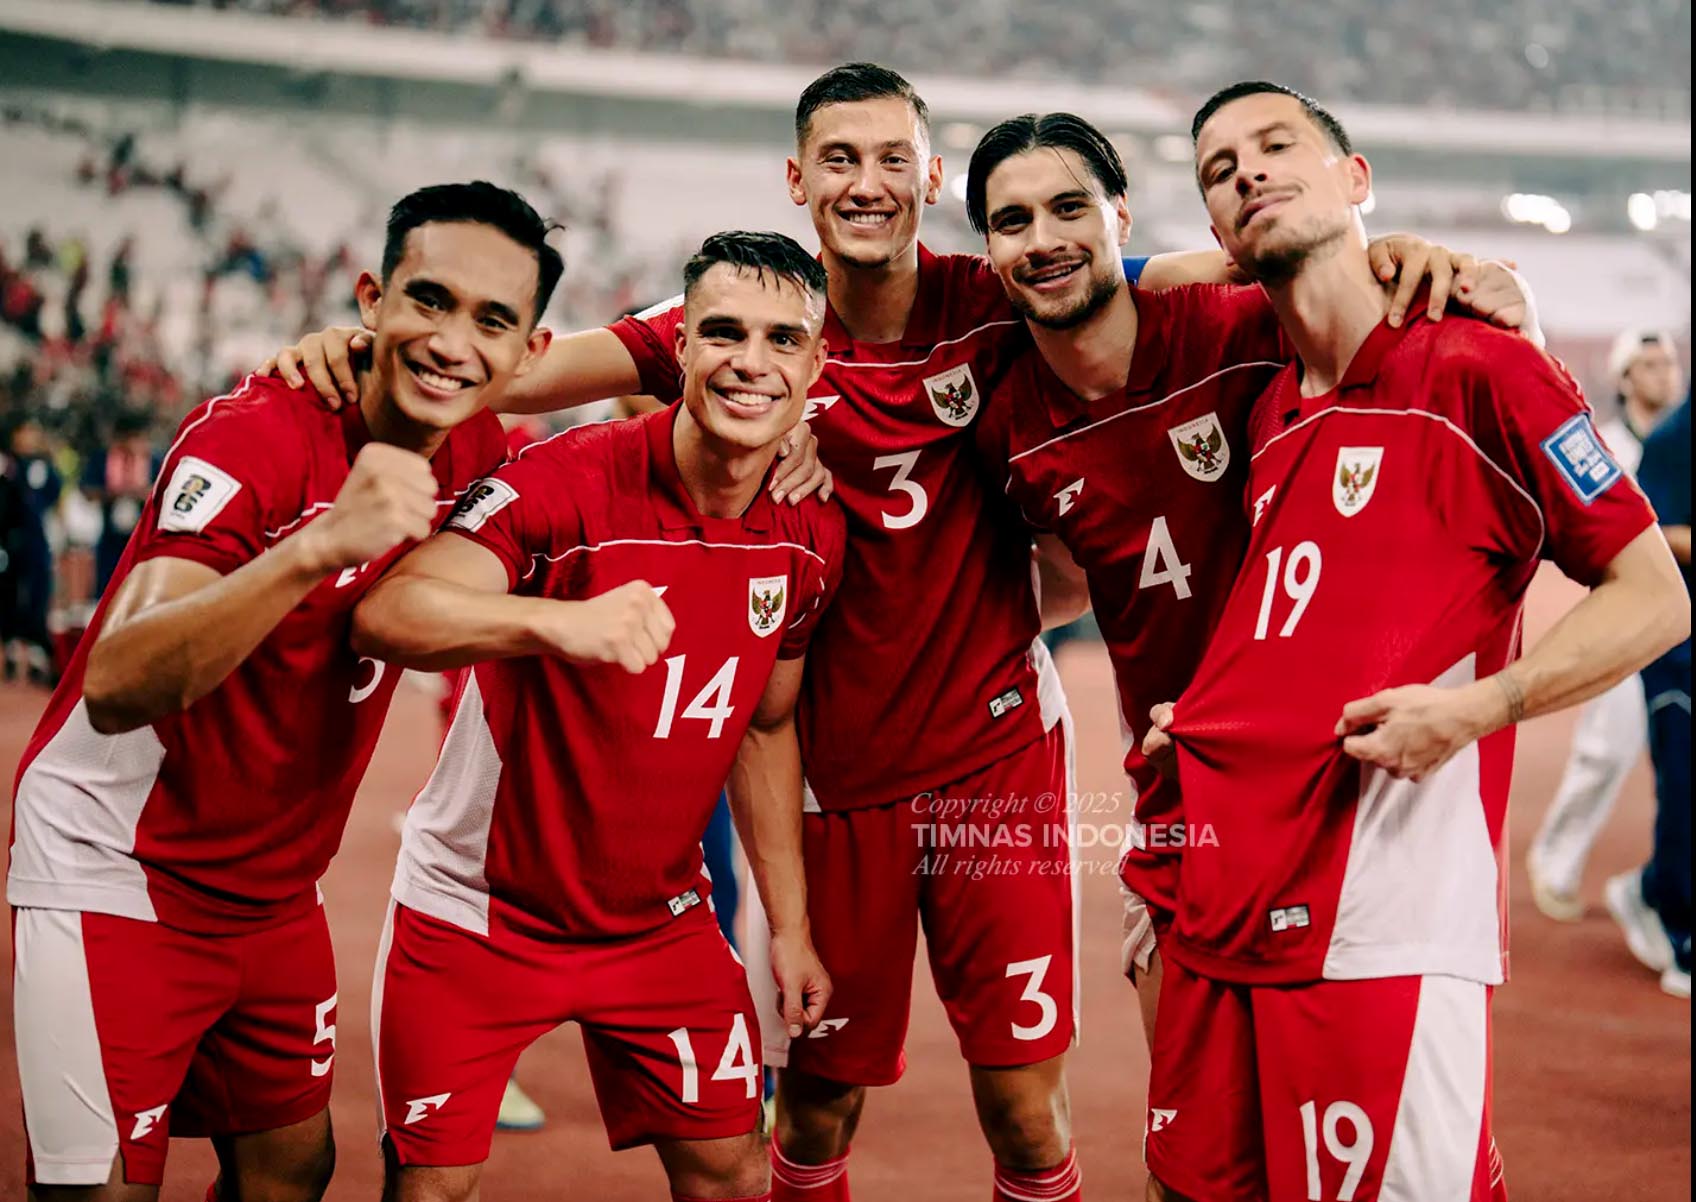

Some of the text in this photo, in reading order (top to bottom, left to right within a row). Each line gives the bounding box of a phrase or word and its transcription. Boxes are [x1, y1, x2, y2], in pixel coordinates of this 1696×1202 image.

[873, 449, 928, 529] 3
[1139, 515, 1192, 600] 4
[1254, 541, 1322, 640] 19
[653, 654, 740, 739] 14
[311, 993, 337, 1077] 5
[1005, 954, 1058, 1041] 3
[667, 1013, 757, 1103] 14
[1299, 1100, 1374, 1202] 19
